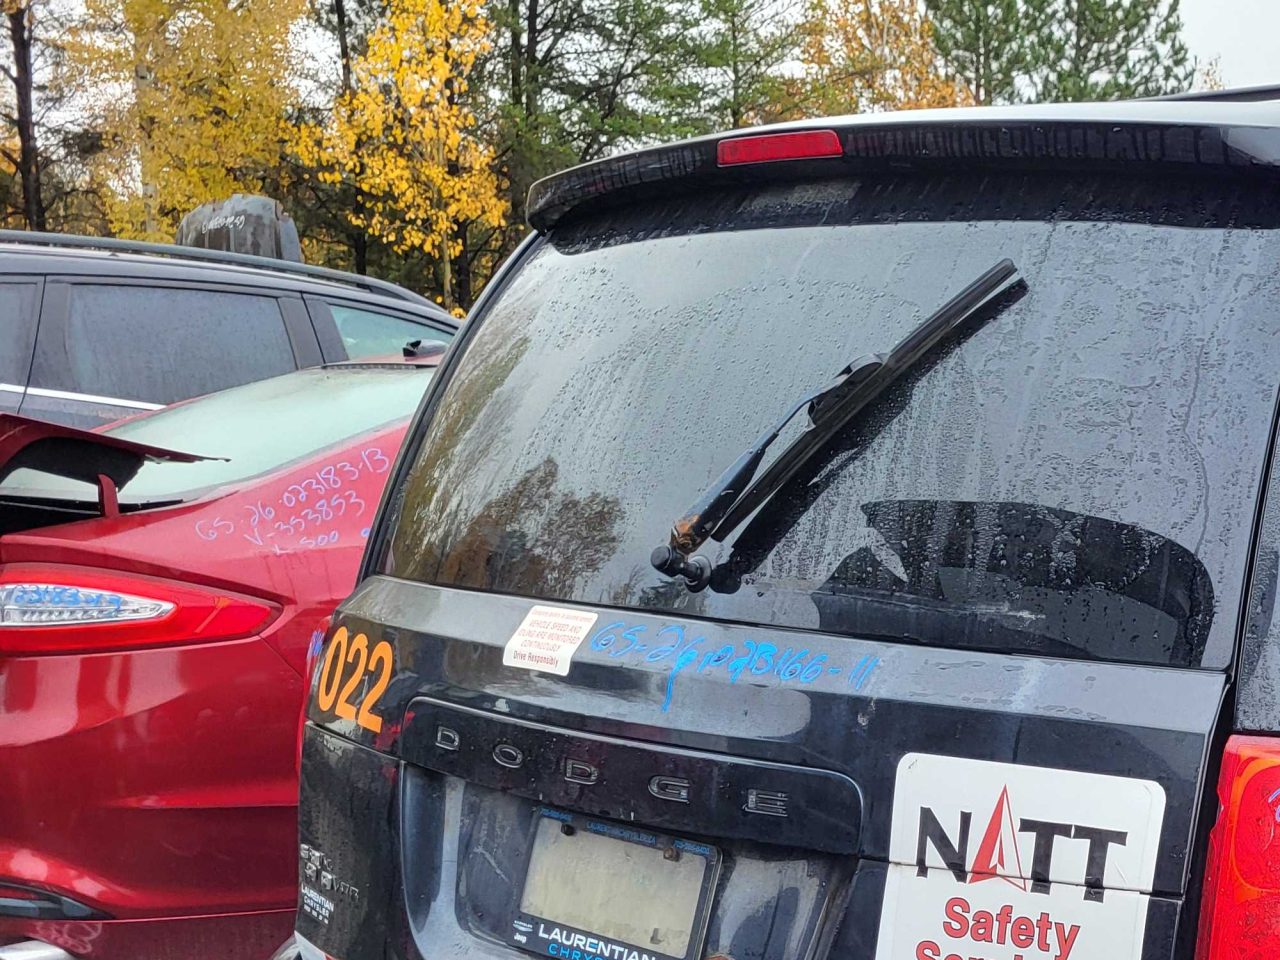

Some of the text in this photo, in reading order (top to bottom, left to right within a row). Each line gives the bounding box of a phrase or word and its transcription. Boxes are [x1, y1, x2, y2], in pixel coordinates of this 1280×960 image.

[318, 626, 393, 734] 022
[513, 650, 559, 668] Drive Responsibly
[436, 725, 789, 817] DODGE
[916, 784, 1128, 903] NATT
